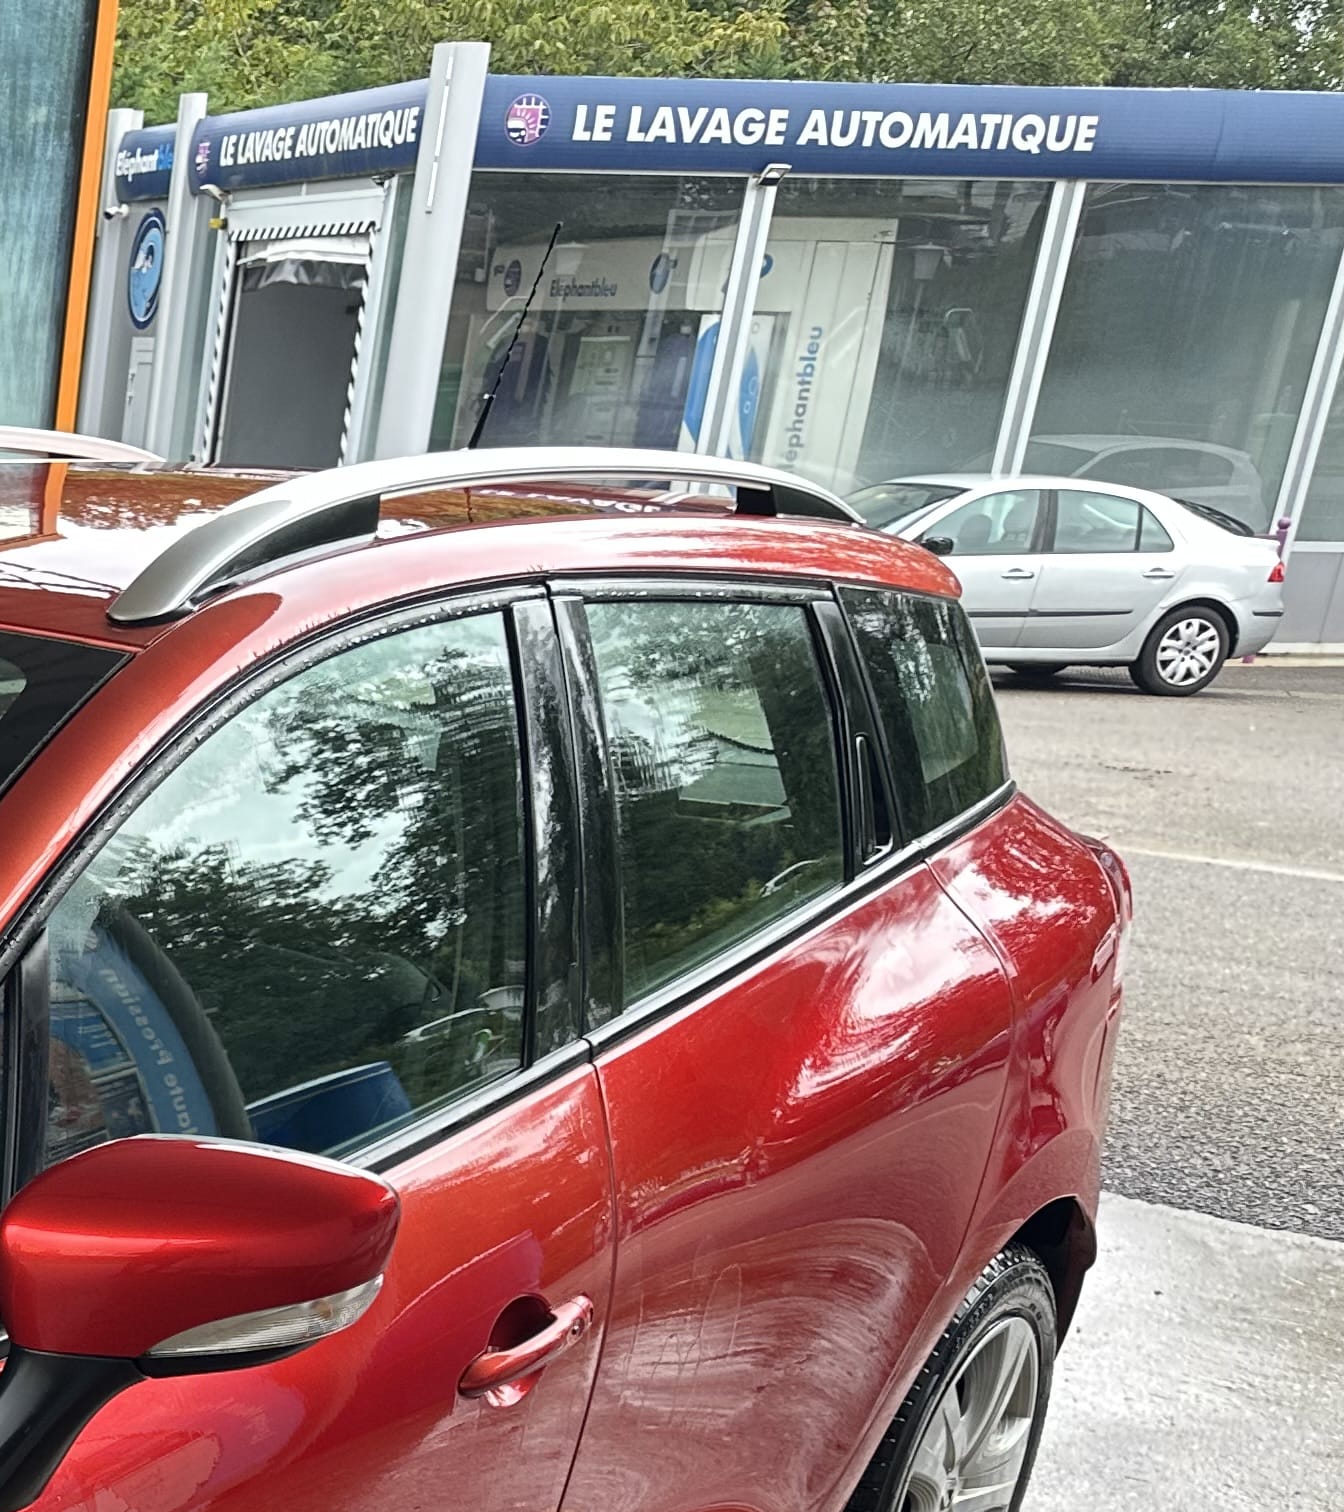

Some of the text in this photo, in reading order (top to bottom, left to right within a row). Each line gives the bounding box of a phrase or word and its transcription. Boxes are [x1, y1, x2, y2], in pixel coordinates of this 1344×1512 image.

[219, 106, 421, 167] LE LAVAGE AUTOMATIQUE
[571, 104, 1100, 155] LE LAVAGE AUTOMATIQUE
